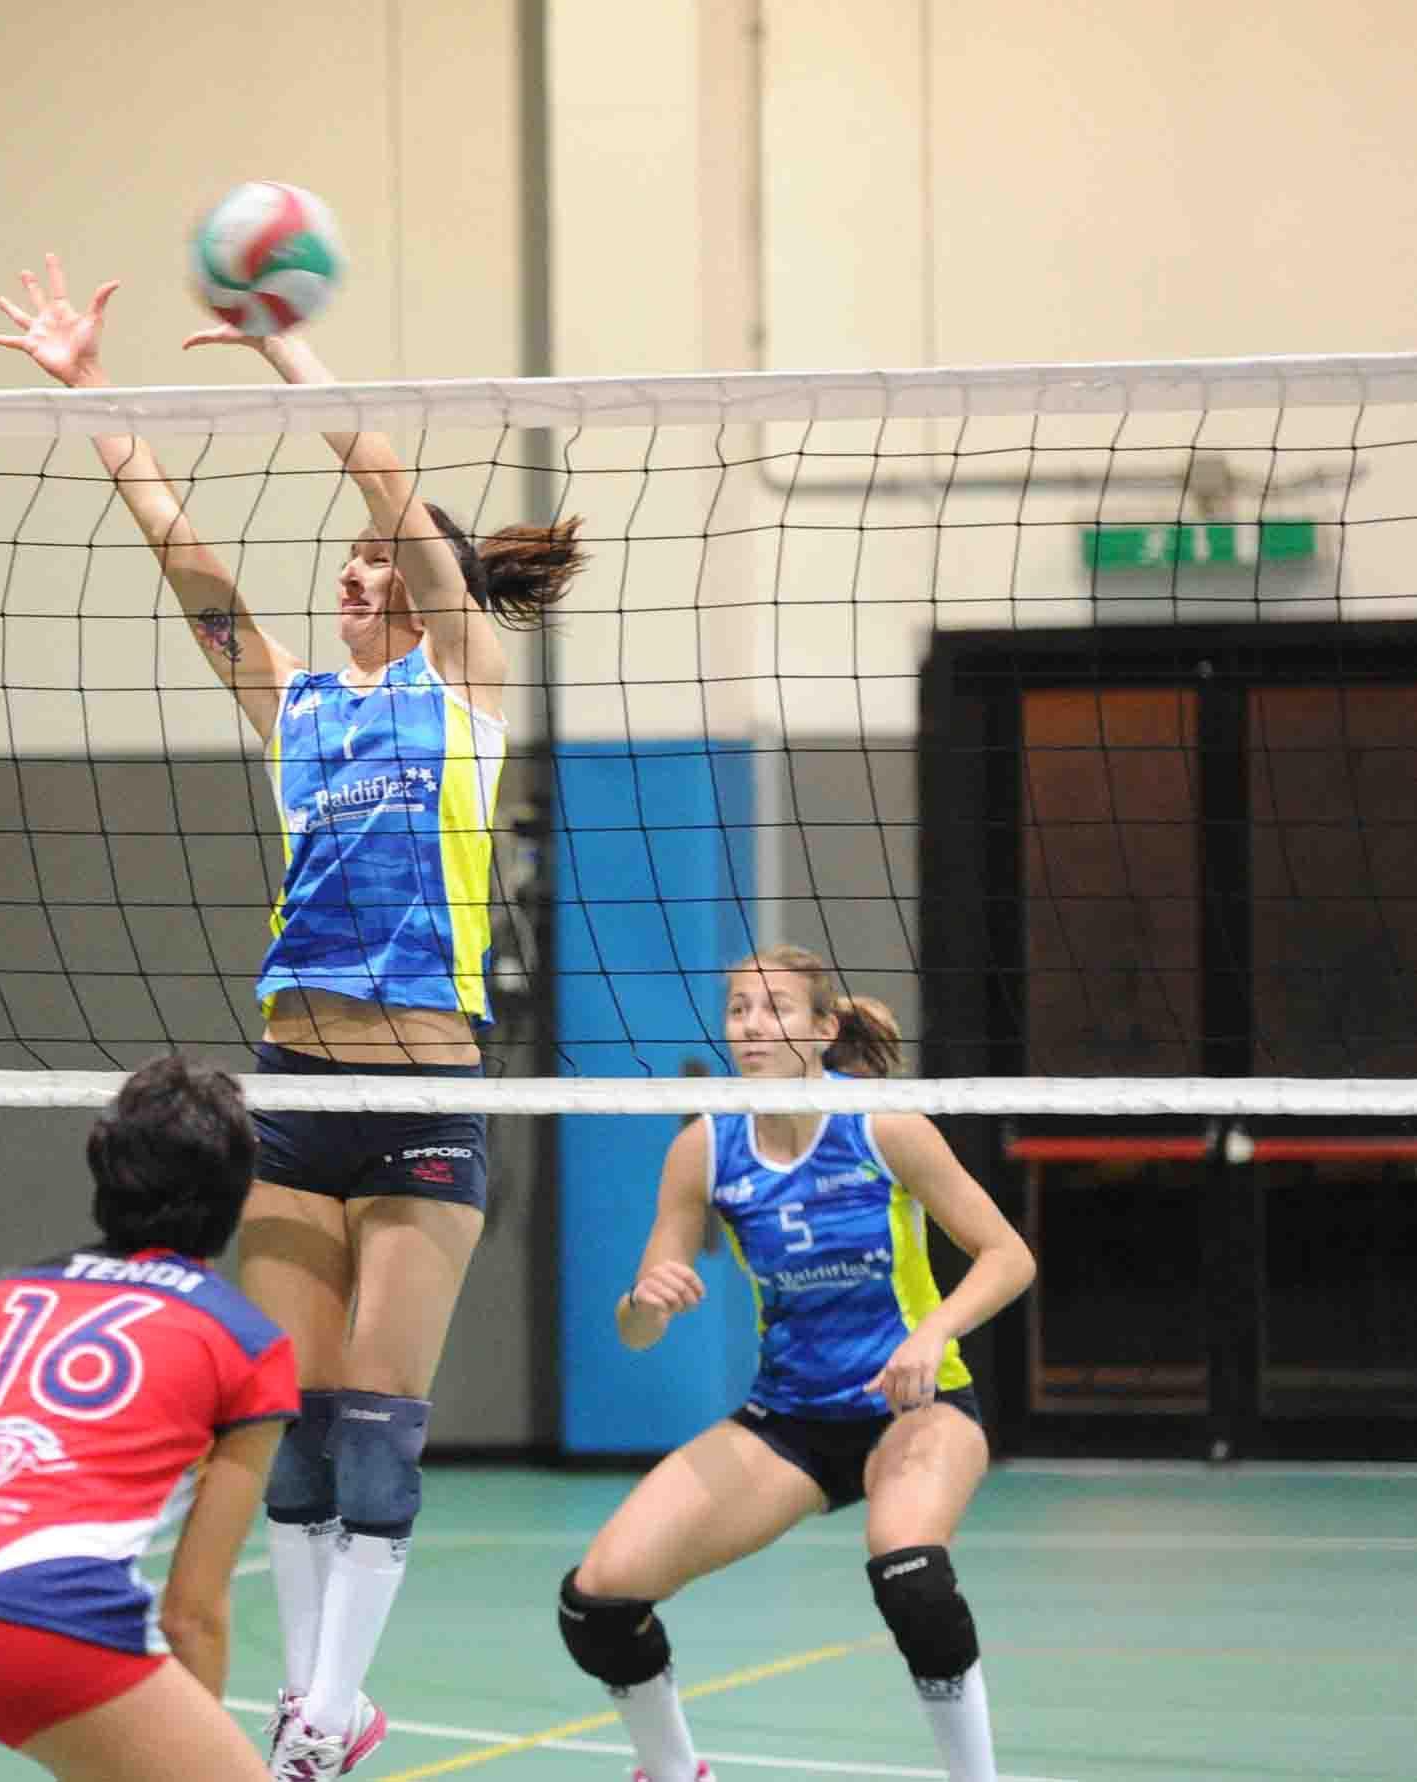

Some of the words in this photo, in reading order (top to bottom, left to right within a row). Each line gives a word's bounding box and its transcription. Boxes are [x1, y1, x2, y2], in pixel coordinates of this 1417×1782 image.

[315, 776, 414, 817] Baldiflex
[779, 1203, 814, 1253] 5
[63, 1254, 206, 1294] TENDI
